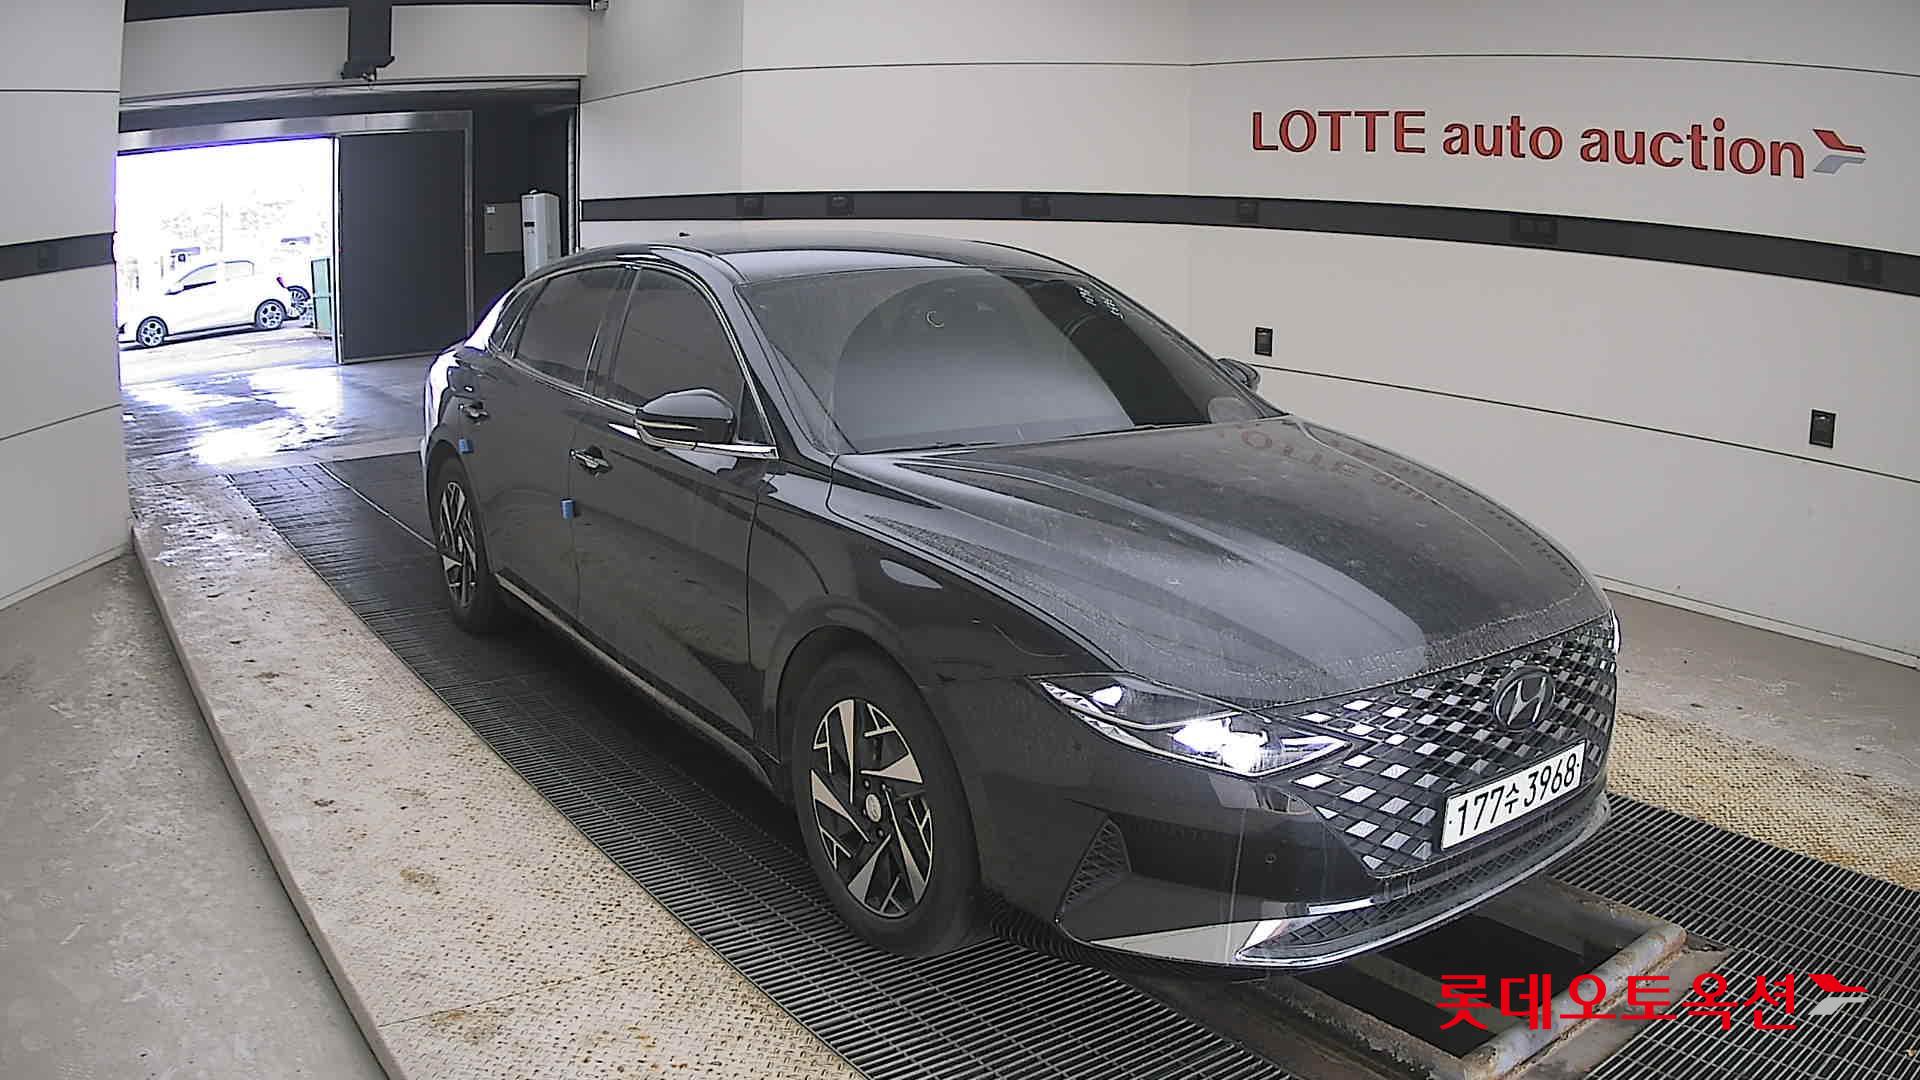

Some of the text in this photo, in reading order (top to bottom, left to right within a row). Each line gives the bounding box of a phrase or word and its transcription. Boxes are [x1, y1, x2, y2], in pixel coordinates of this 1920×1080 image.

[1251, 110, 1806, 179] LOTTE auto auction
